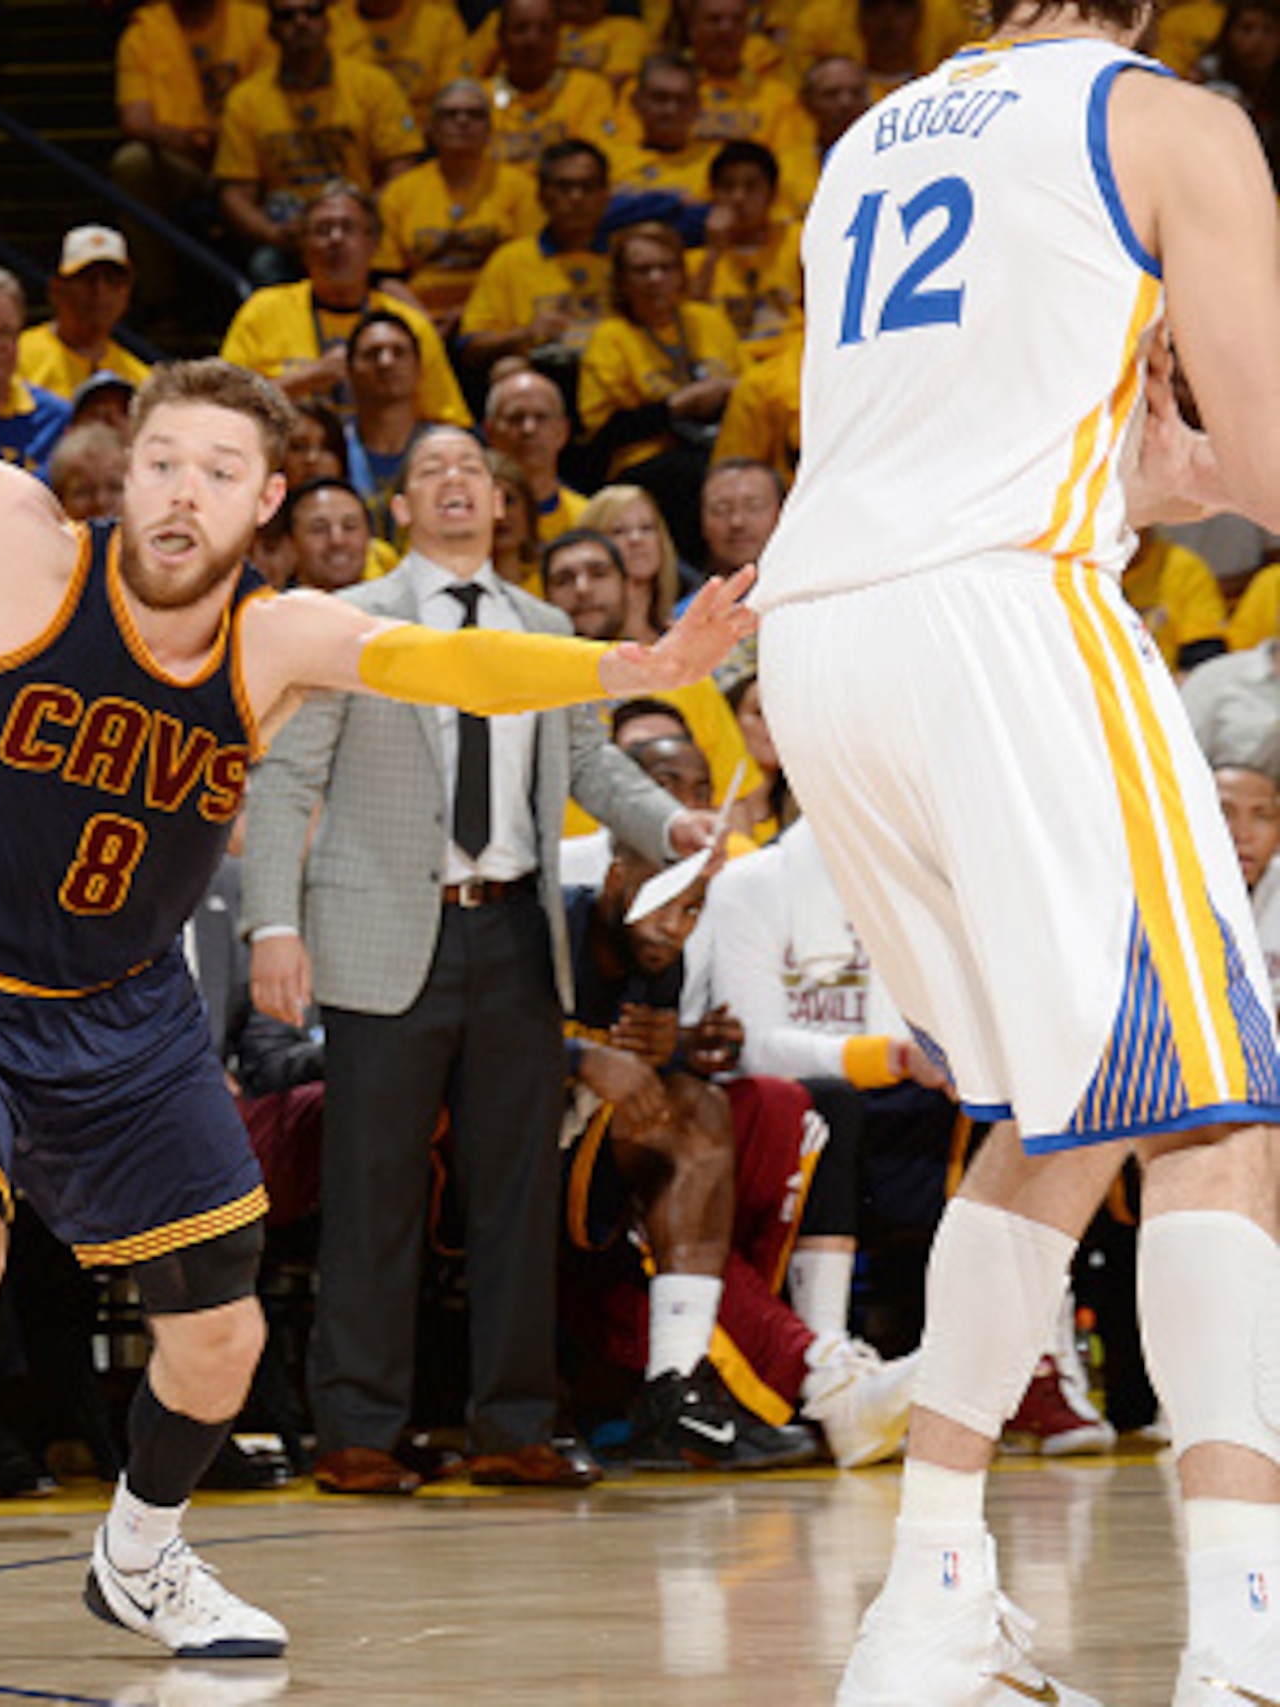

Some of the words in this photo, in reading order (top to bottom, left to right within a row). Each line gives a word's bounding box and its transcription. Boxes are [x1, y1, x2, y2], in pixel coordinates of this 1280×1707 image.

[874, 90, 1021, 154] BOGUT
[835, 174, 975, 348] 12
[58, 813, 148, 915] 8
